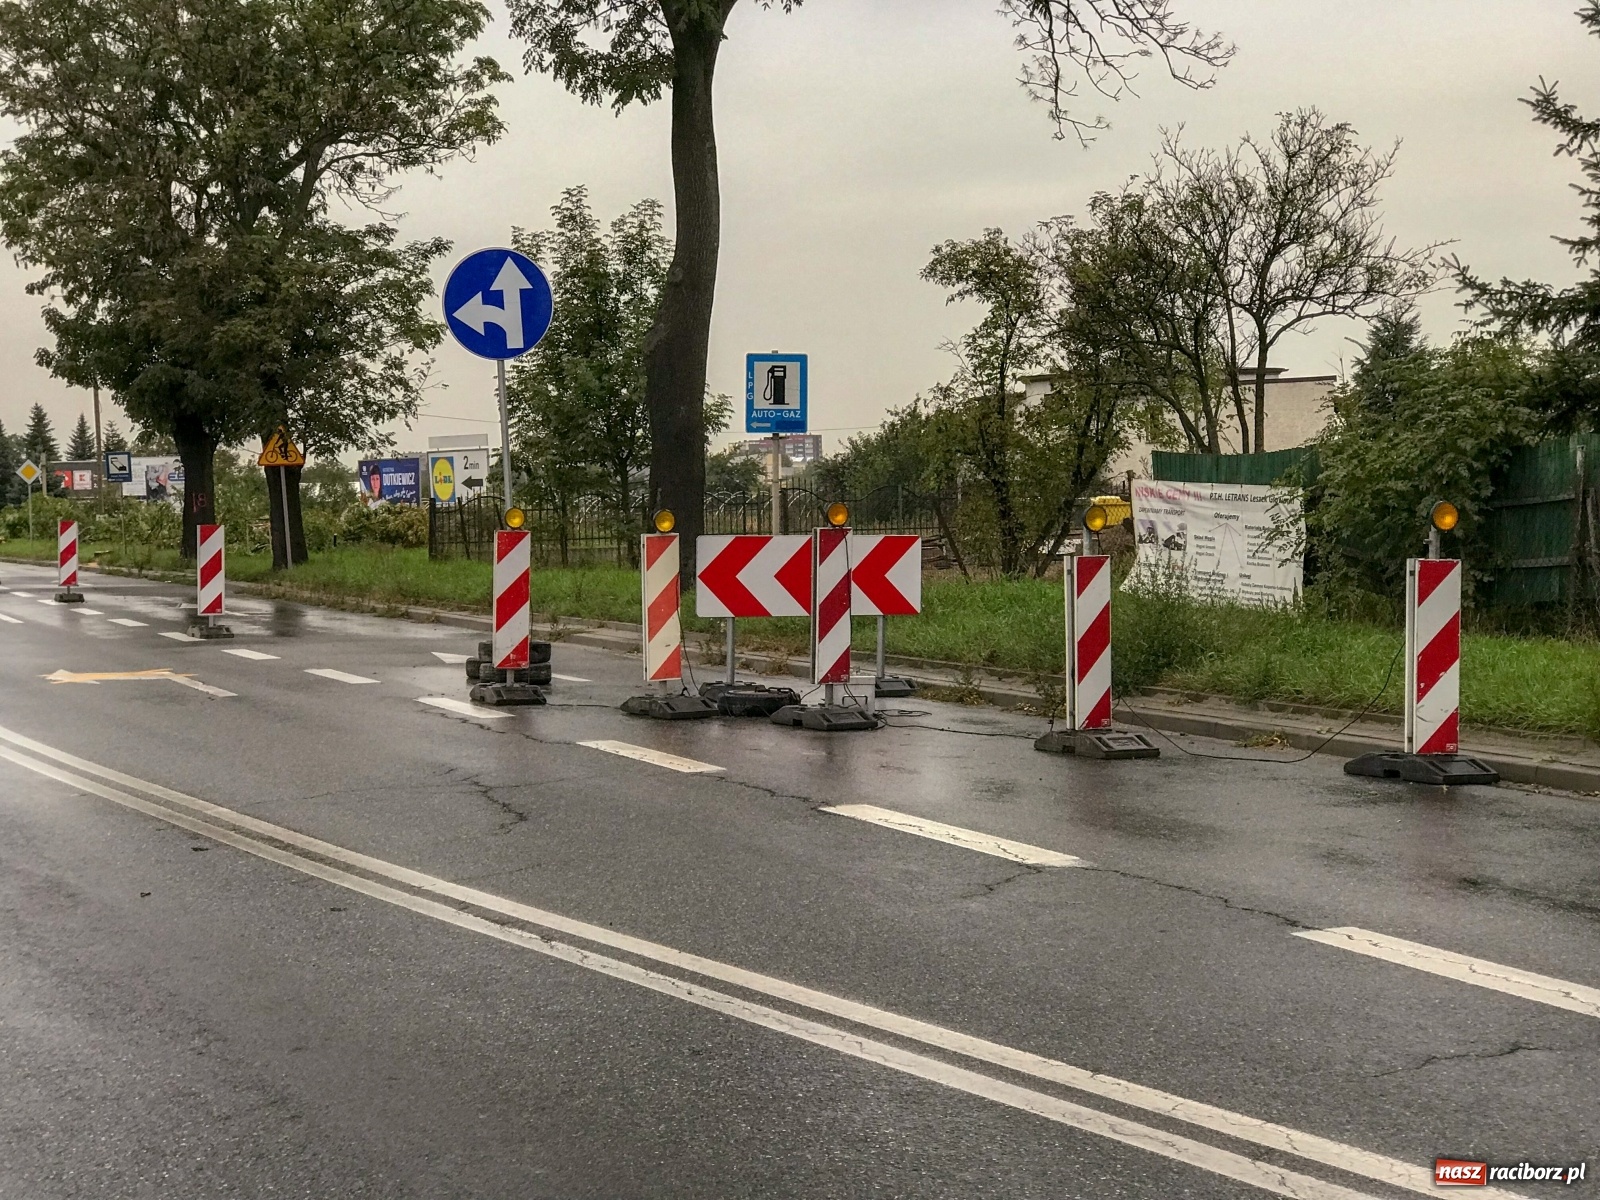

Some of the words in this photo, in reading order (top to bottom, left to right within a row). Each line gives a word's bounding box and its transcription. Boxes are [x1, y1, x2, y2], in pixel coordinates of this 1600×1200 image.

[751, 410, 801, 418] AUTO-GAZ
[463, 455, 469, 470] 2
[469, 460, 480, 470] min
[382, 472, 416, 486] DUTKIEWICZ
[1224, 492, 1249, 502] LETRANS
[1163, 508, 1186, 516] TRANSPORT
[1213, 512, 1240, 521] Oferujemy
